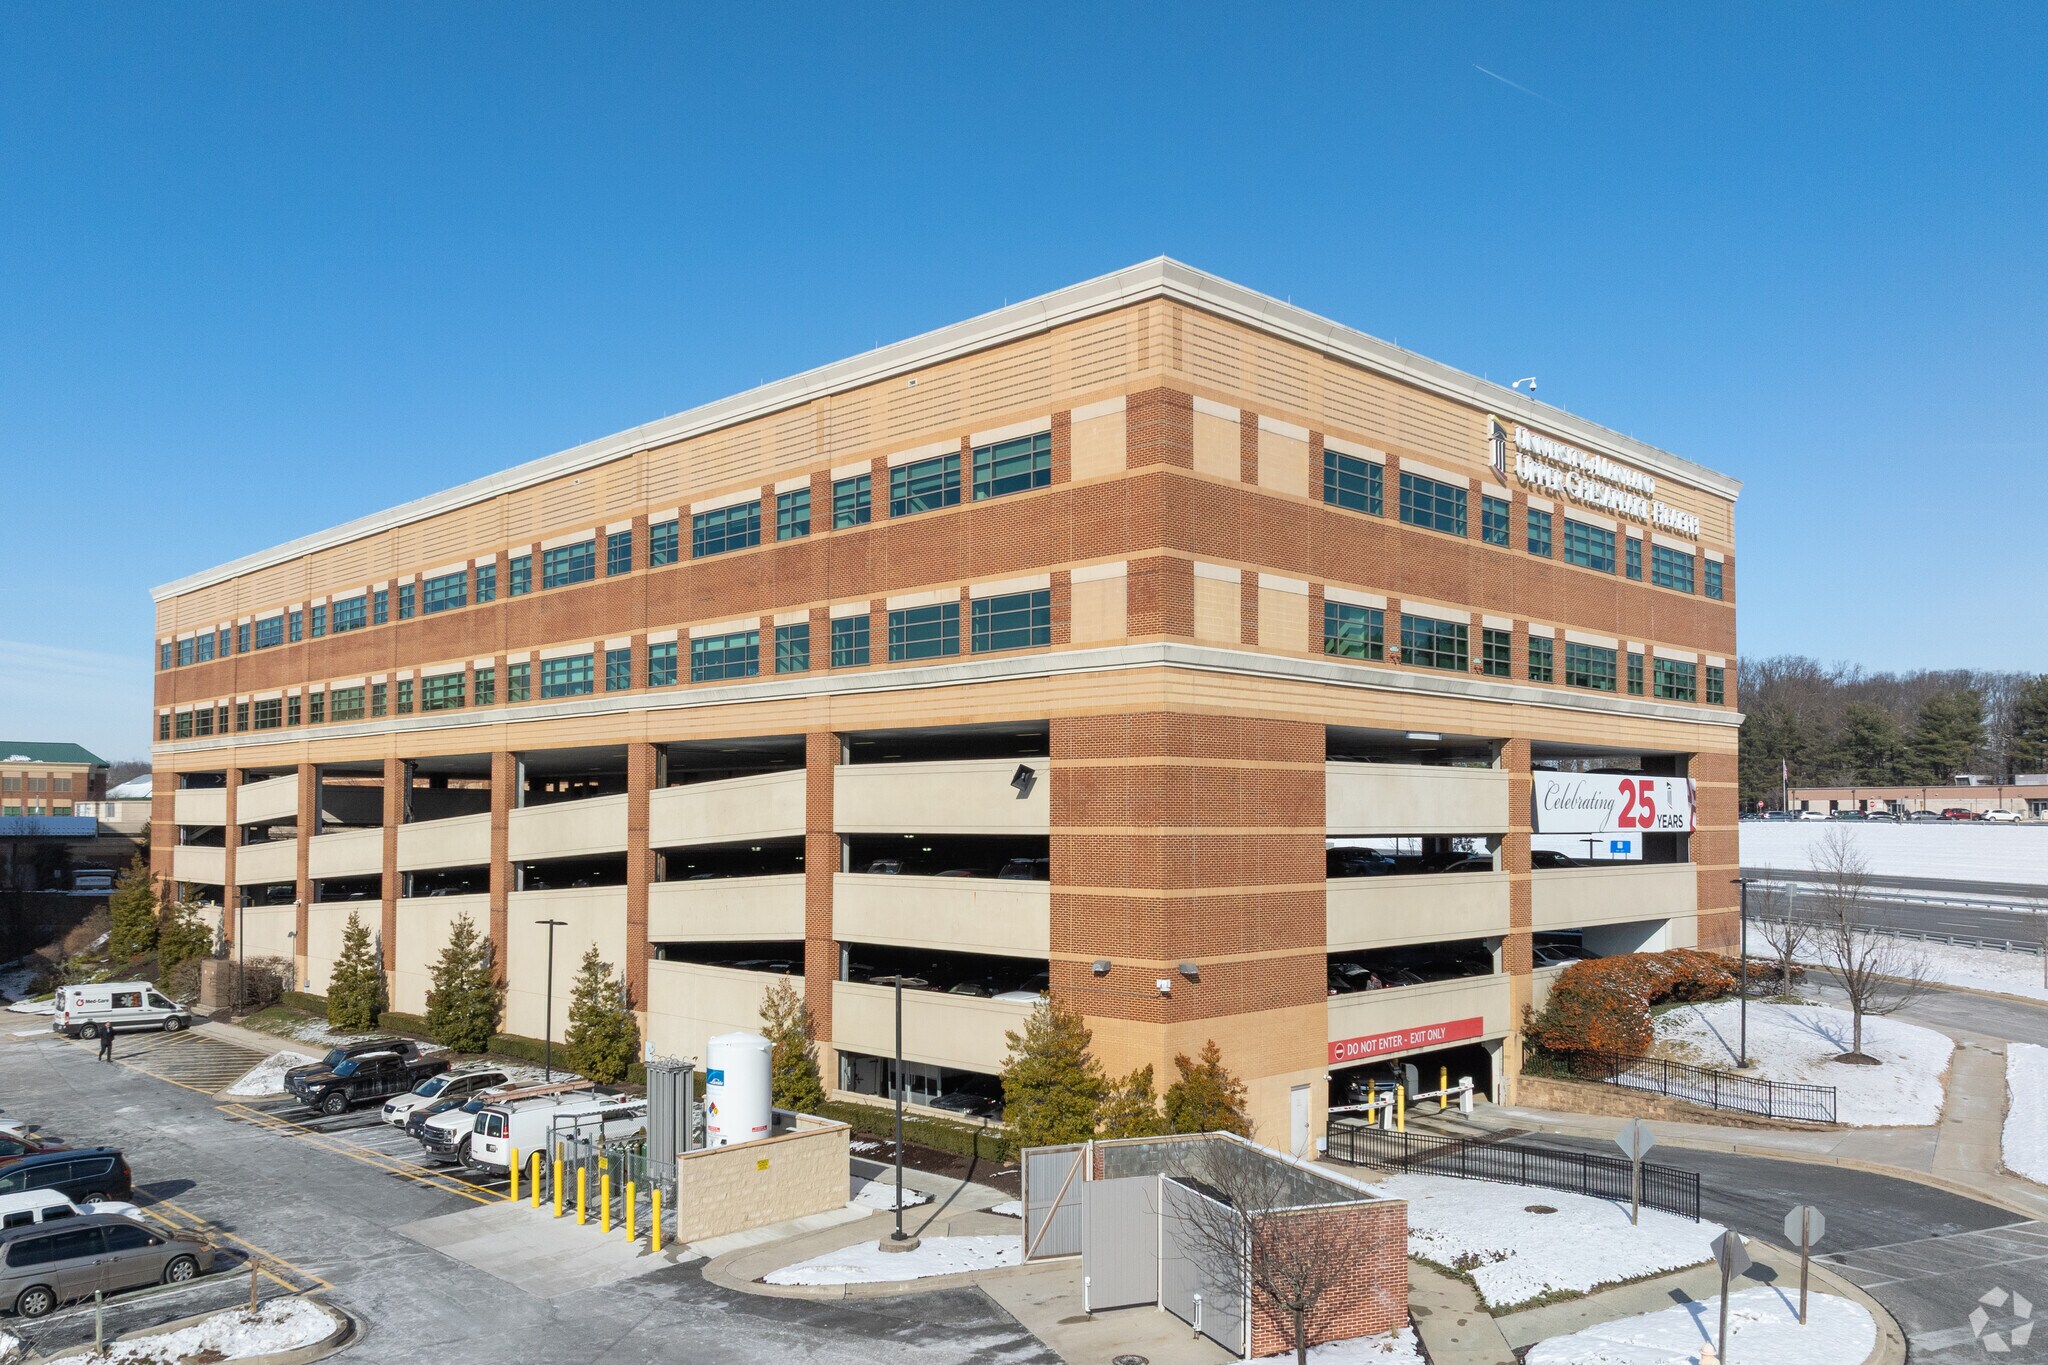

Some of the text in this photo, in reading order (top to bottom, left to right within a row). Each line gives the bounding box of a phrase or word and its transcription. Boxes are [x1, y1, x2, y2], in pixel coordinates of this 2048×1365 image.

[1544, 778, 1684, 832] Celebrating 25 YEARS
[1347, 1043, 1358, 1056] DO
[1360, 1040, 1377, 1053] NOT
[1378, 1035, 1402, 1050] ENTER
[1410, 1031, 1426, 1044] EXIT
[1428, 1027, 1446, 1041] ONLY
